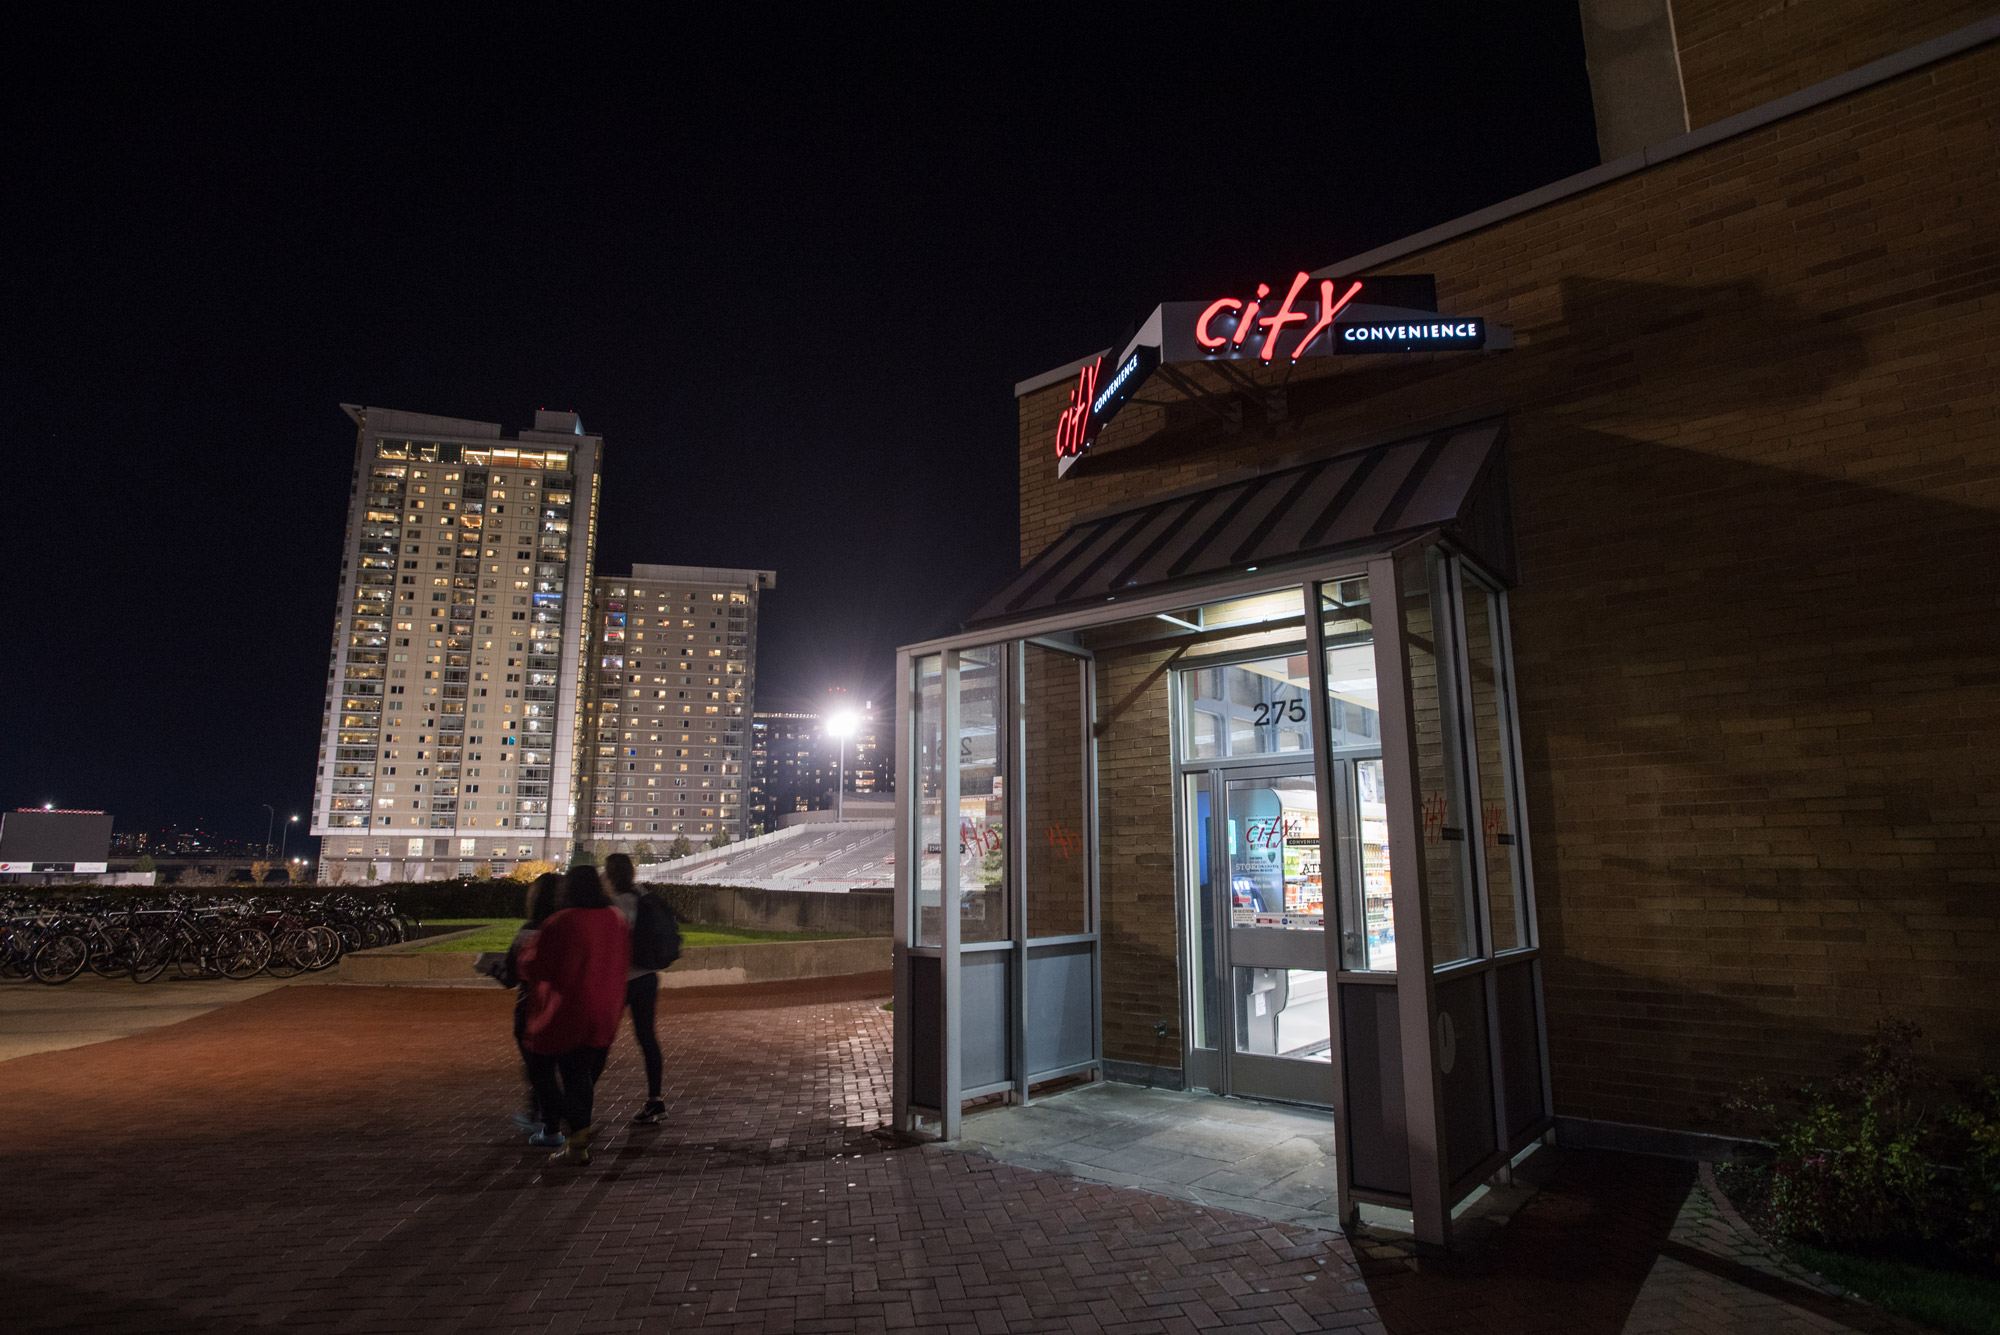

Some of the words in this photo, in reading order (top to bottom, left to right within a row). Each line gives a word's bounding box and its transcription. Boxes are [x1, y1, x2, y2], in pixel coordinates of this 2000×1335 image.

[1196, 271, 1363, 361] city
[1344, 322, 1477, 342] CONVENIENCE
[1055, 355, 1102, 458] city
[1093, 354, 1139, 414] CONVENIENCE
[1253, 699, 1306, 727] 275
[1245, 816, 1298, 849] city
